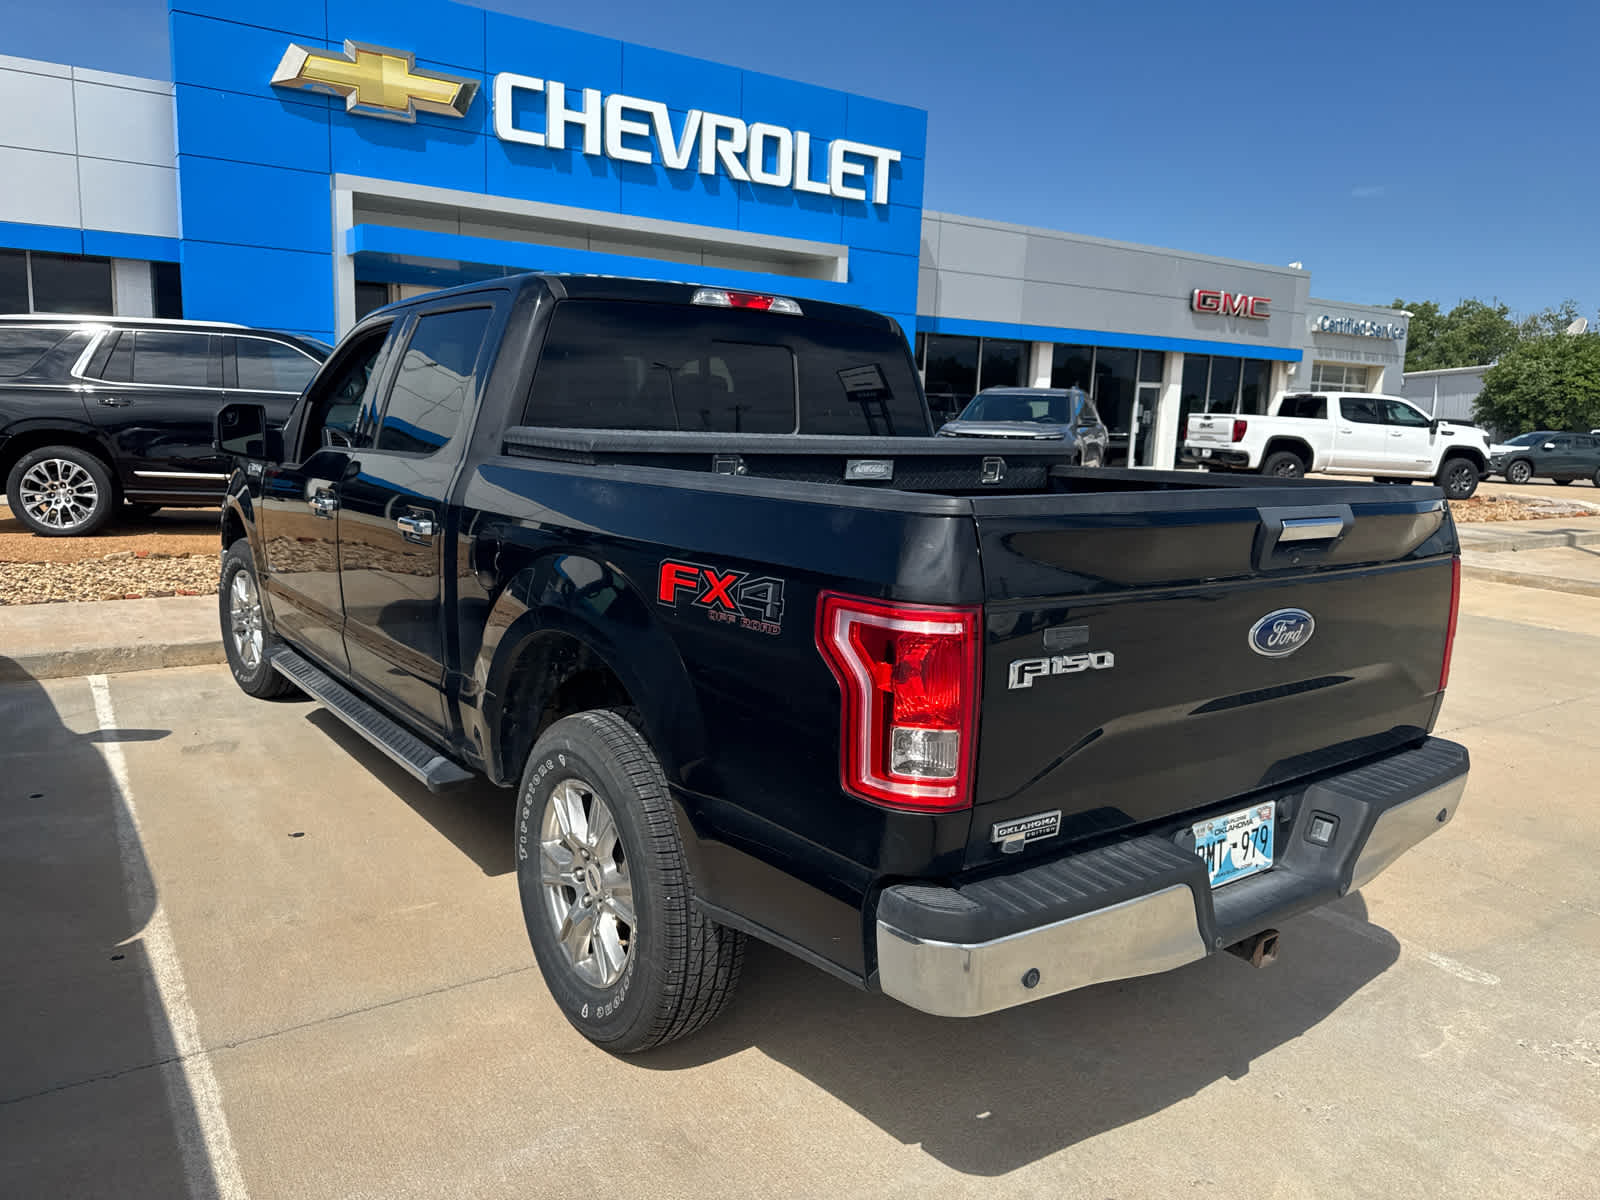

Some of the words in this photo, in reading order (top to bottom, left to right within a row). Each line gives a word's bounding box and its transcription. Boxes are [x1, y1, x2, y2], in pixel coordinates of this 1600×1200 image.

[492, 72, 902, 205] CHEVROLET
[1193, 289, 1272, 320] GMC
[1317, 315, 1367, 337] Certified
[1369, 320, 1406, 340] Service
[657, 558, 785, 625] FX4
[740, 617, 782, 635] ROAD
[1267, 619, 1304, 647] Ford
[1000, 817, 1057, 836] OKLAHOMA
[1214, 818, 1254, 836] OKLAHOMA
